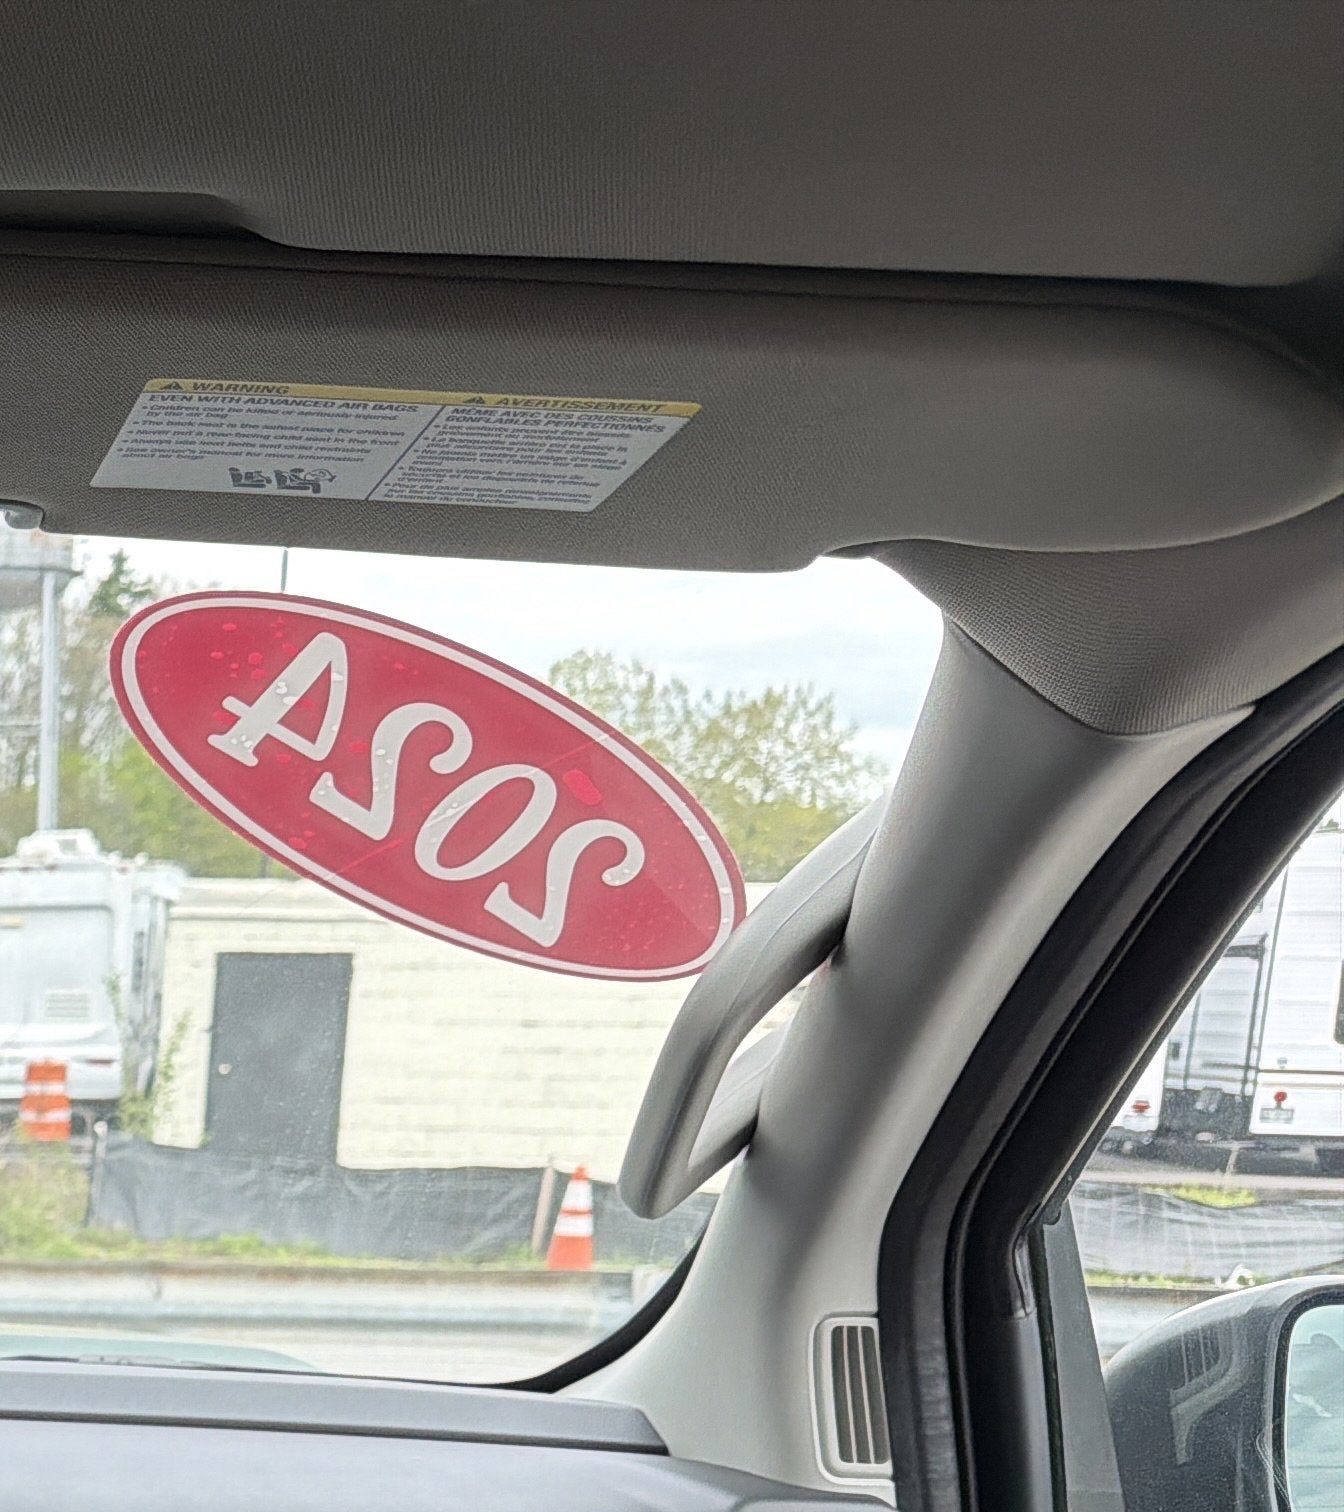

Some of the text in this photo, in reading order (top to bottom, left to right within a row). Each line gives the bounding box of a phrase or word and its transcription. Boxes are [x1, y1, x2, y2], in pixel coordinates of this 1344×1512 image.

[192, 381, 290, 395] WARNING
[148, 394, 419, 413] EVEN WITH ADVANCED AIR BAGS
[496, 397, 664, 412] AVERTISSEMENT
[445, 415, 543, 426] GONFLABLES
[501, 409, 542, 418] AVEC
[544, 412, 574, 420] DES
[577, 413, 654, 424] COUSSINS
